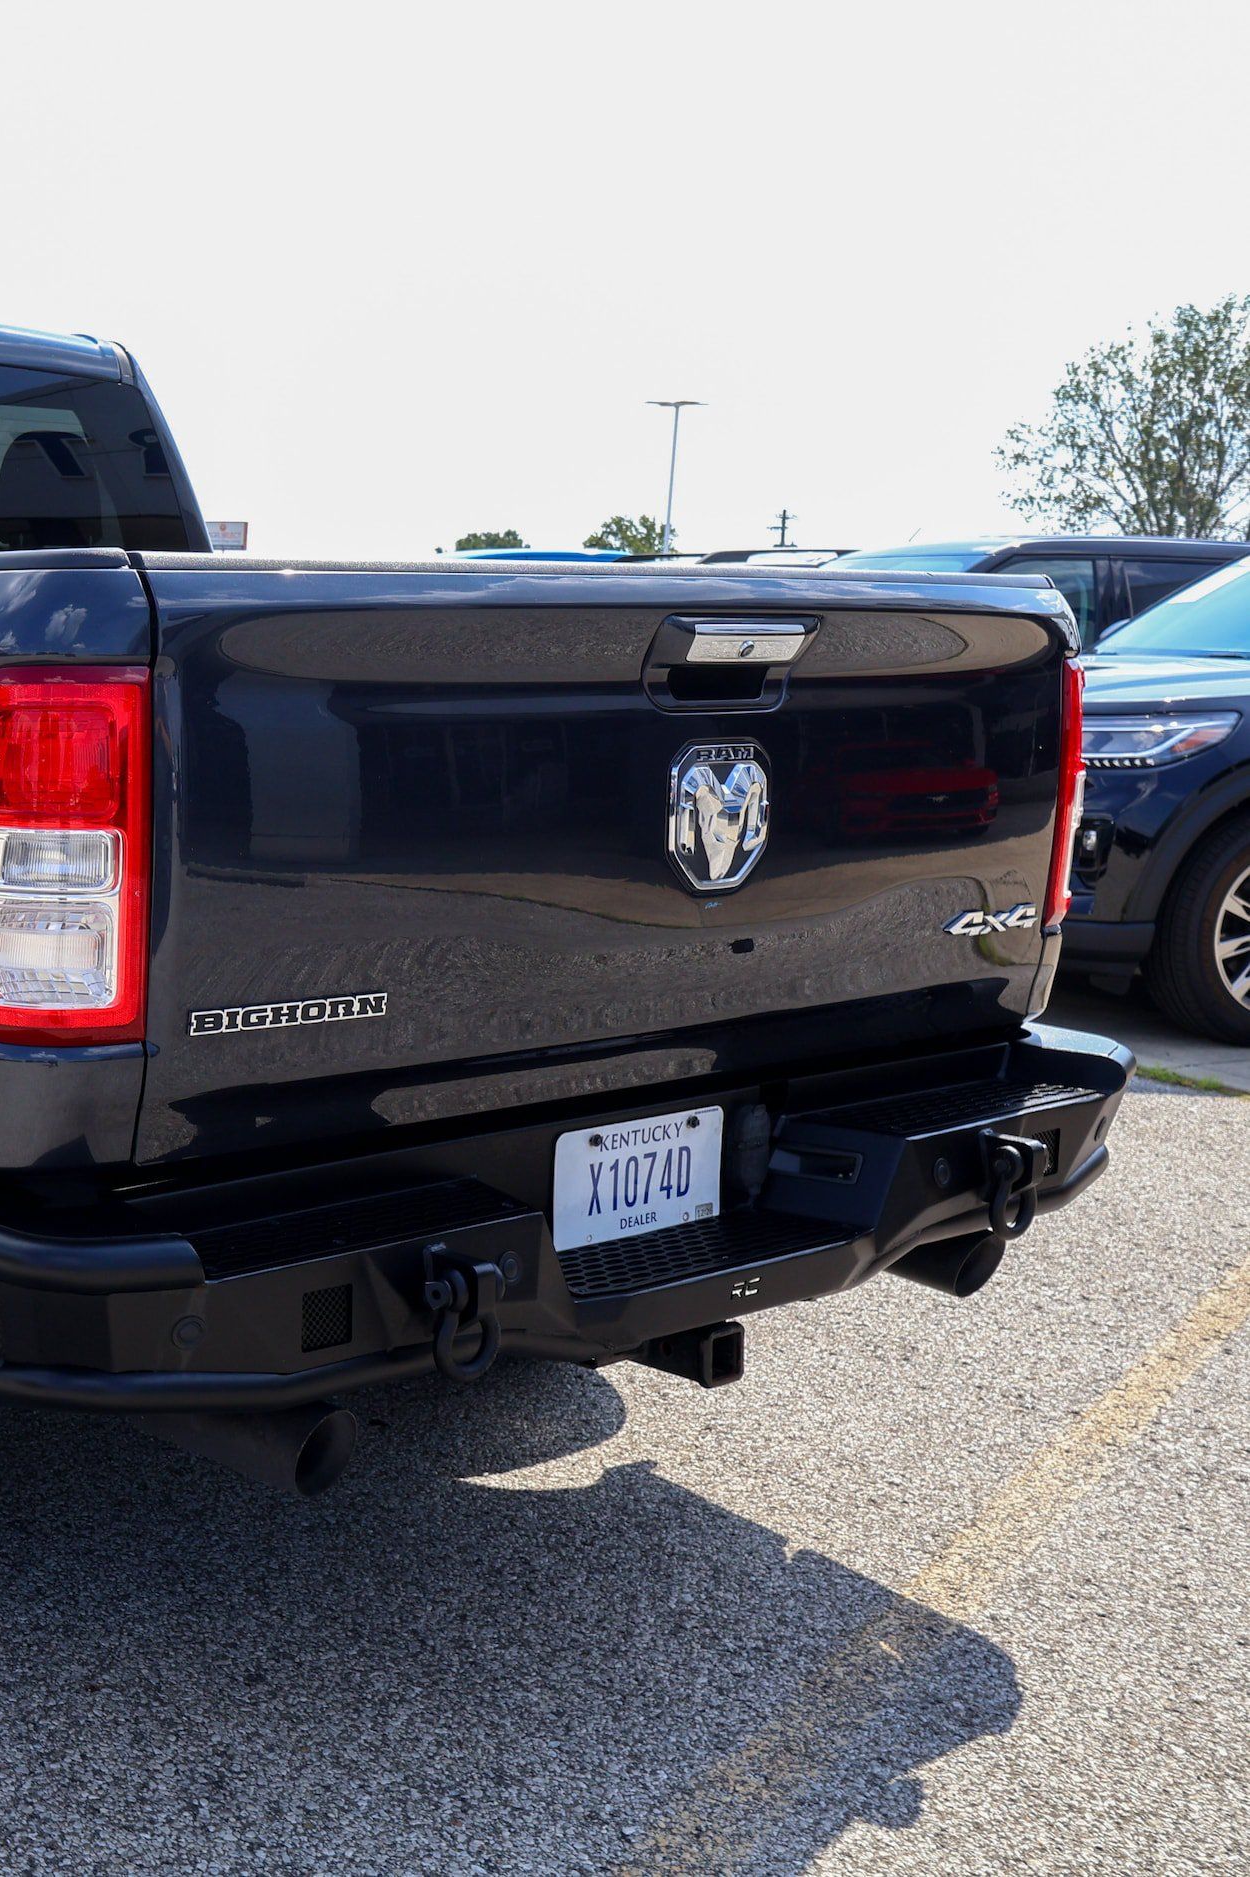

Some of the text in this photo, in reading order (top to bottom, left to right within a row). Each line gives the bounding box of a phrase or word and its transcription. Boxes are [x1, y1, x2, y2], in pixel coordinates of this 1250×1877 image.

[697, 747, 754, 761] RAM
[190, 992, 388, 1037] BIGHORN
[599, 1121, 684, 1152] KENTUCKY
[588, 1145, 691, 1216] X1074D
[620, 1211, 657, 1230] DEALER
